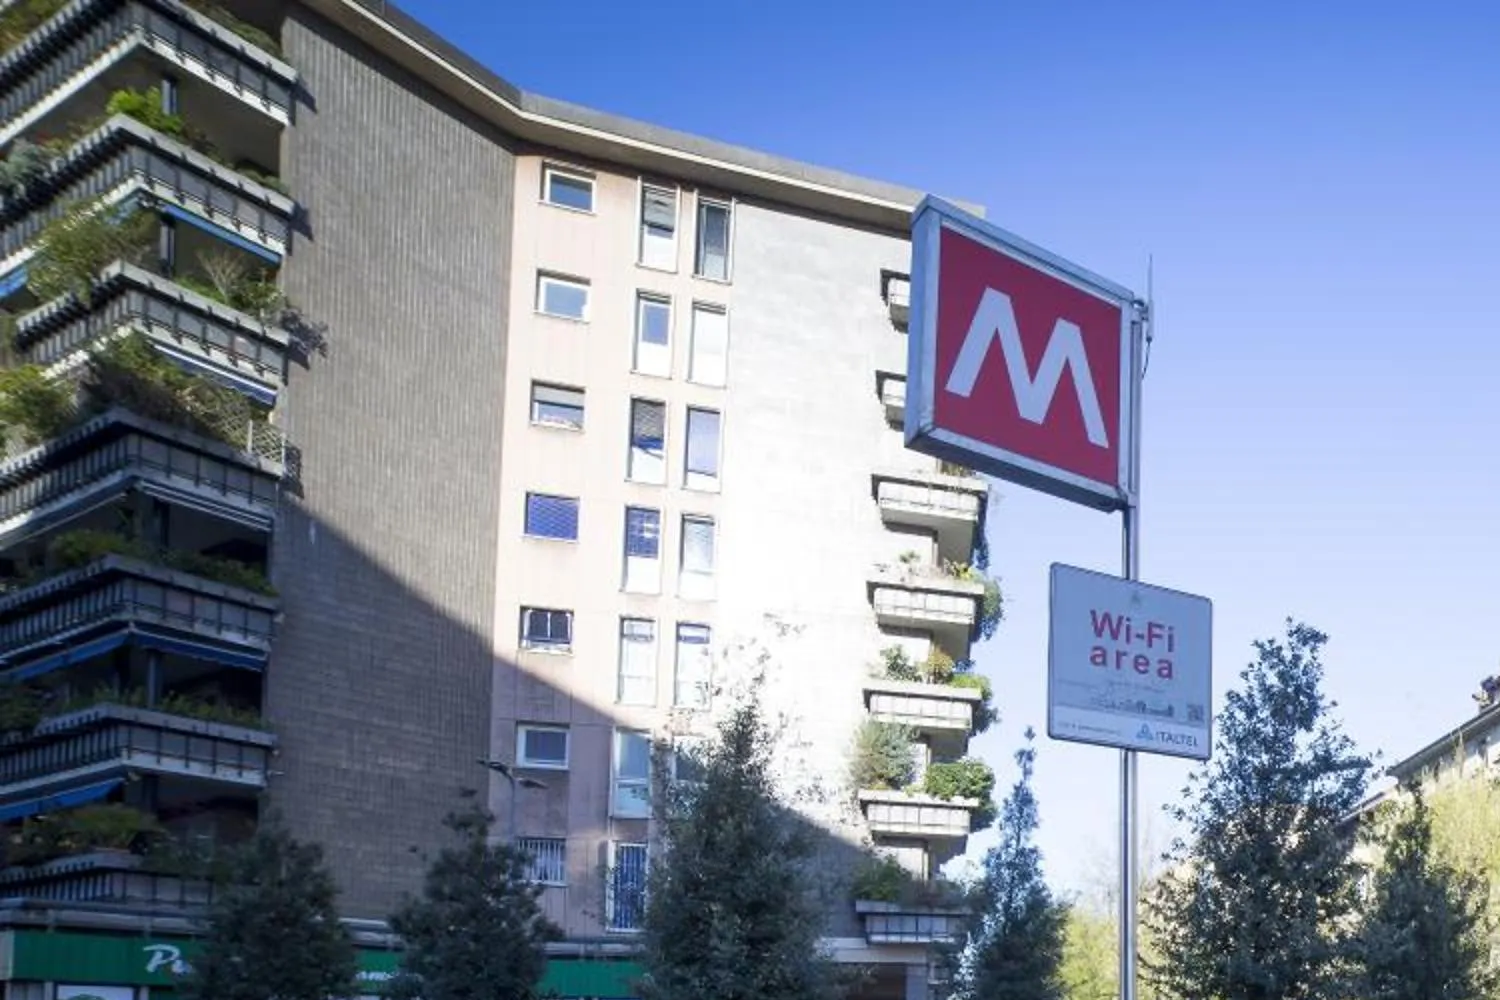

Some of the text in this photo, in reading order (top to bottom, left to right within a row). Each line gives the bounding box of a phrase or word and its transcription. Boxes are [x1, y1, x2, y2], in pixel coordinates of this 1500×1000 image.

[945, 287, 1109, 449] M
[1089, 609, 1175, 653] Wi-Fi
[1089, 645, 1174, 680] area
[1156, 730, 1199, 748] ITALTEL
